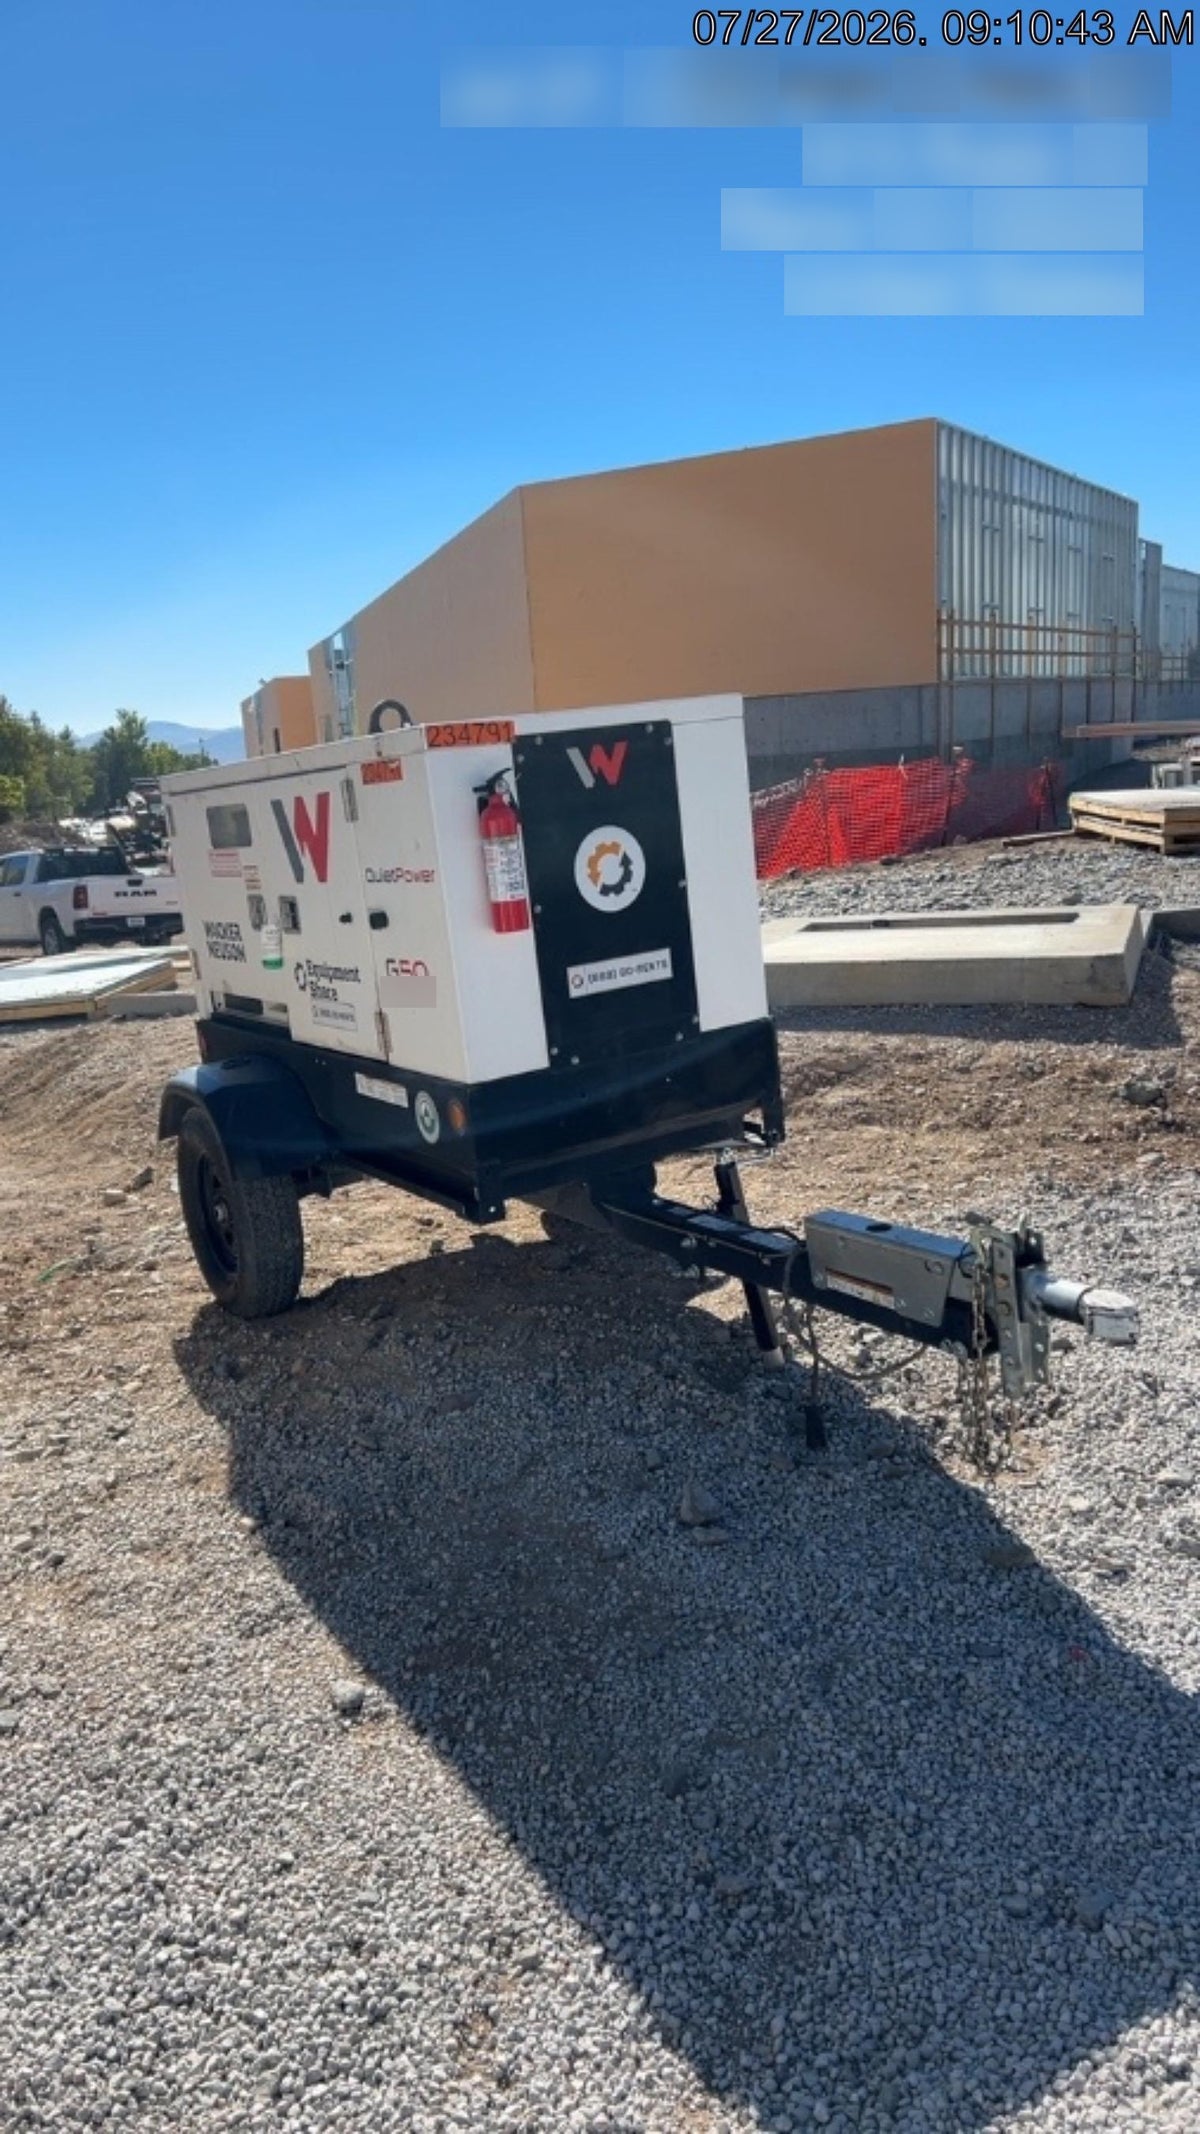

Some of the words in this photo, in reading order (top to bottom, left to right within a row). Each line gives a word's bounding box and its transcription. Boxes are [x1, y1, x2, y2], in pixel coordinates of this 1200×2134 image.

[427, 721, 513, 747] 234791
[364, 867, 435, 883] QuietPower
[305, 959, 361, 984] Equipment
